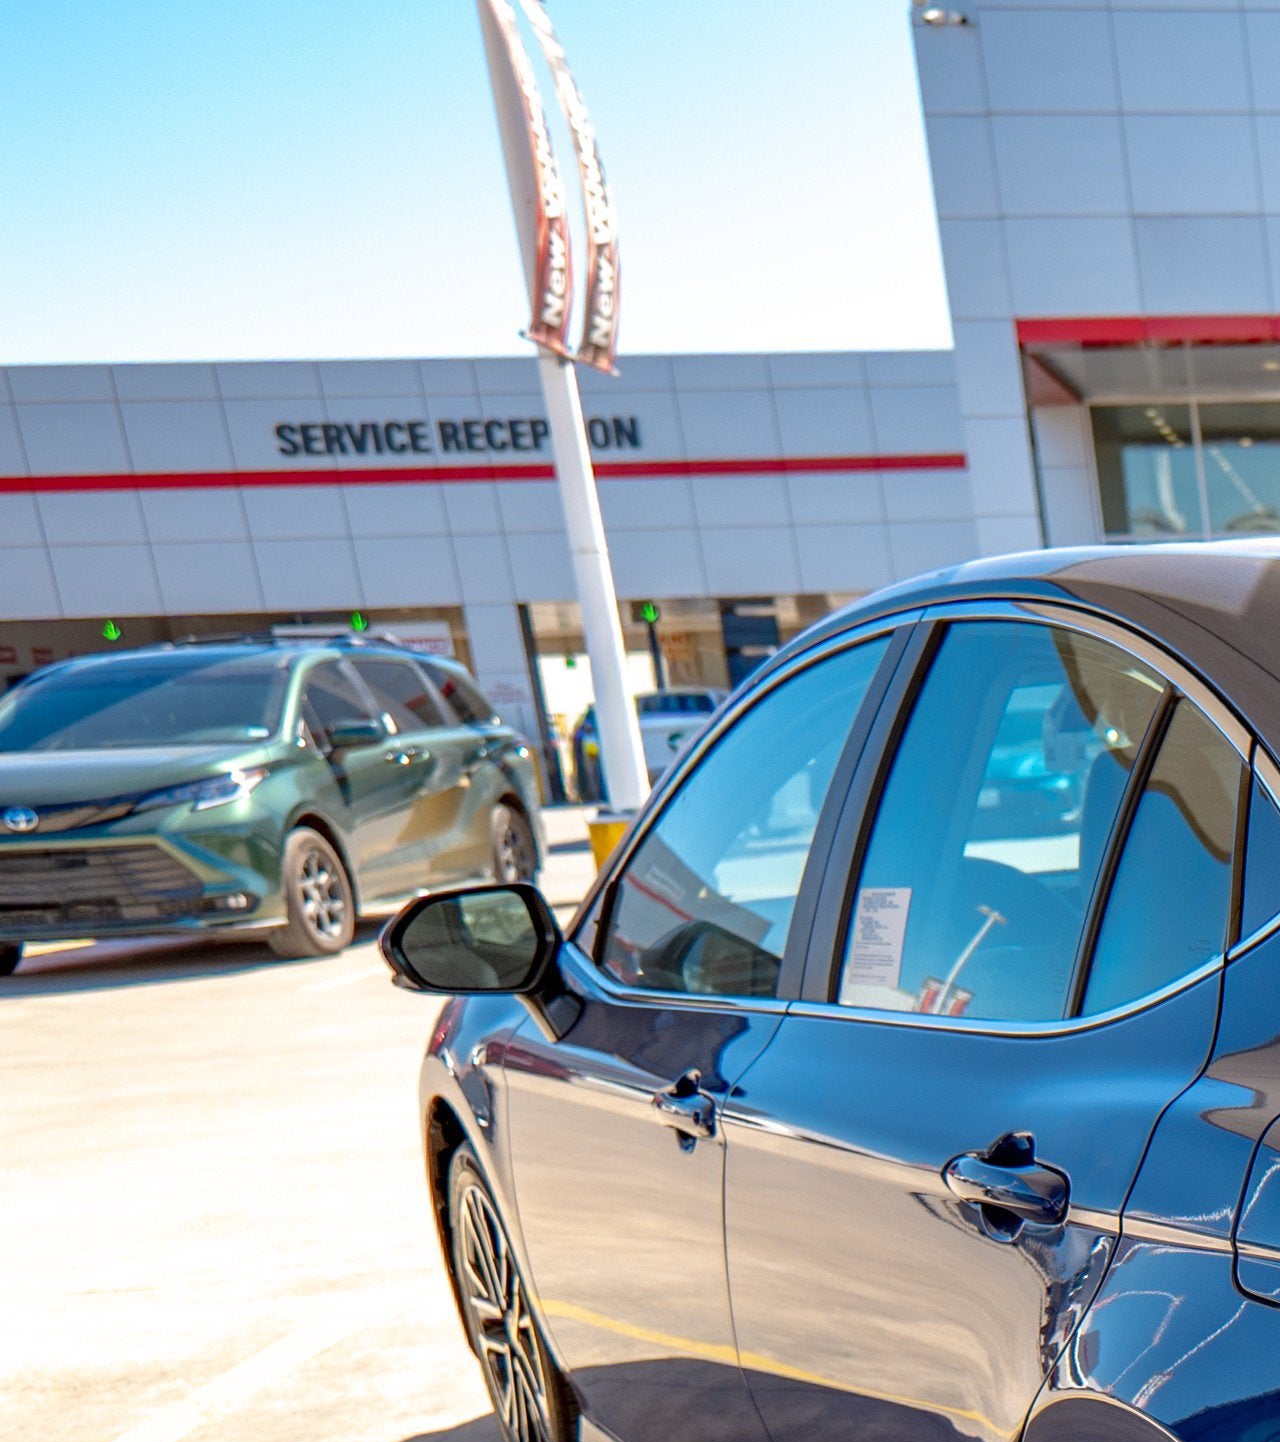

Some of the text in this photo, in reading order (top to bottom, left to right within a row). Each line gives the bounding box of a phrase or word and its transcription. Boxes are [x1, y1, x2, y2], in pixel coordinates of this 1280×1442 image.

[541, 227, 566, 329] New
[589, 251, 614, 348] New
[275, 414, 643, 457] SERVICE RECEPON
